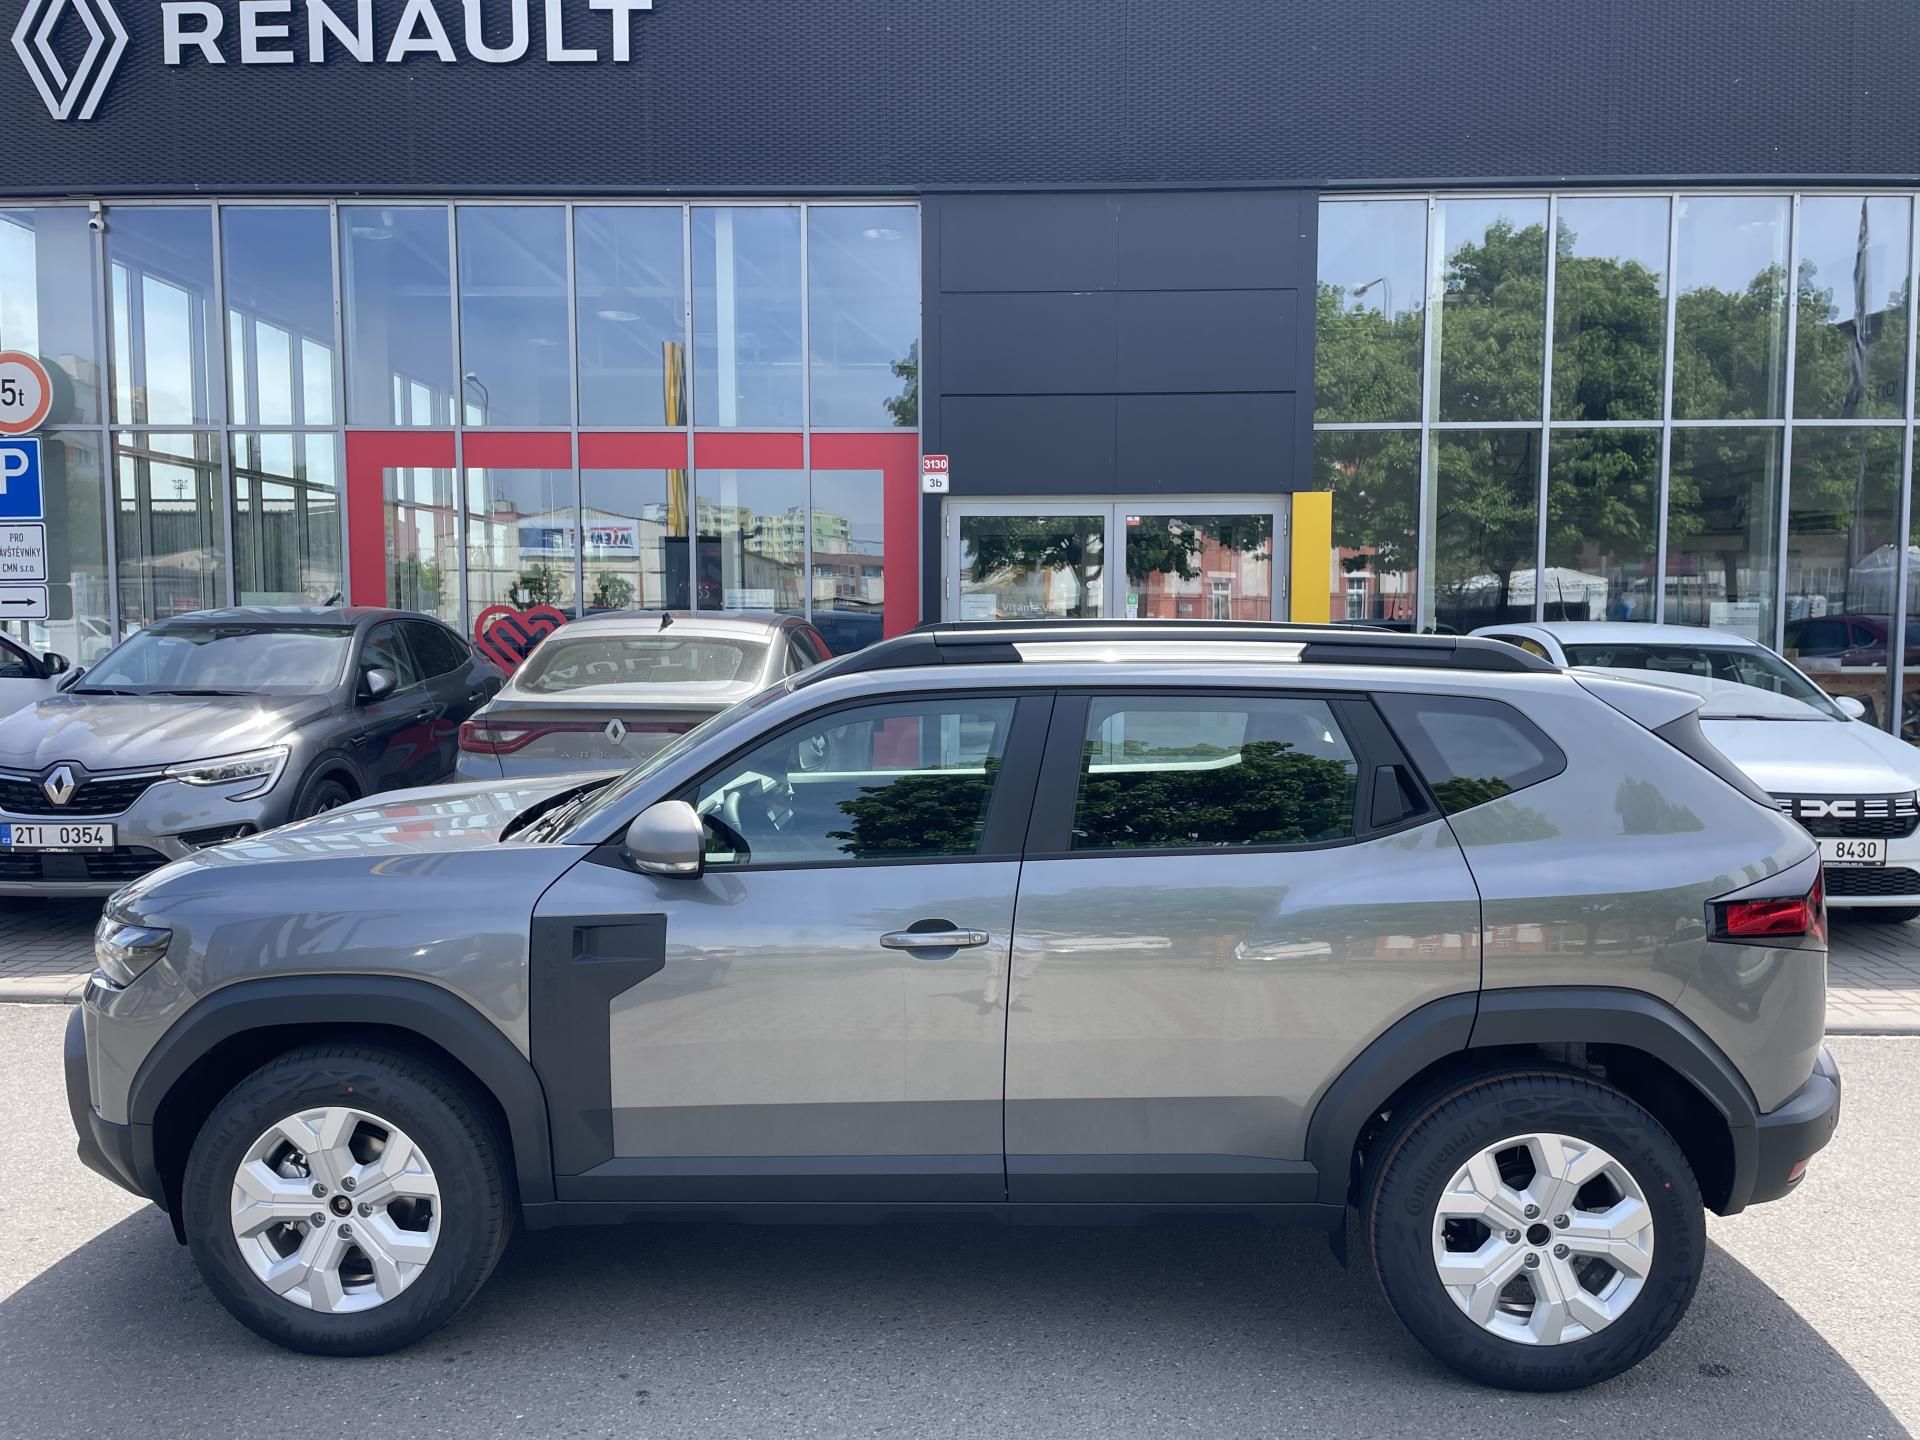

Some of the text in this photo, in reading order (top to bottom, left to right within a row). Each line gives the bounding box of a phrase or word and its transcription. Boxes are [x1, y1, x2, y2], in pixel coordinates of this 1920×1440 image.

[161, 0, 653, 65] RENAULT
[924, 459, 947, 469] 3130
[929, 478, 942, 488] 3b
[9, 533, 24, 543] PRO
[2, 563, 36, 573] CMN s.r.o.
[59, 826, 104, 844] 0354
[1835, 841, 1878, 858] 8430
[1404, 1121, 1477, 1217] Continental
